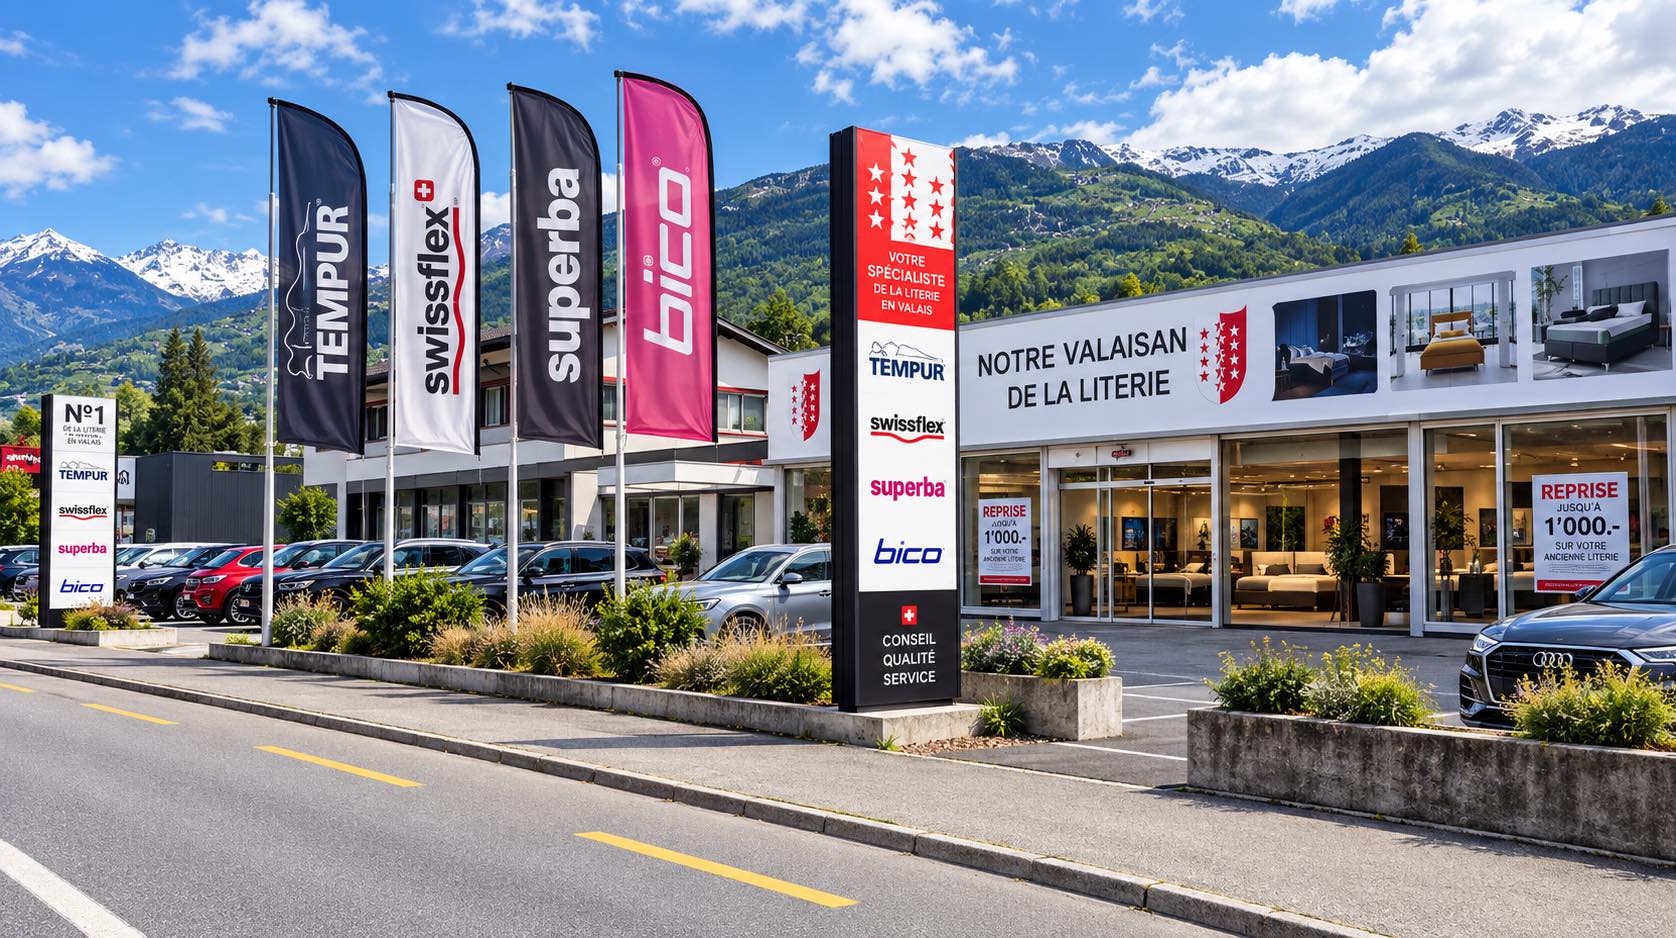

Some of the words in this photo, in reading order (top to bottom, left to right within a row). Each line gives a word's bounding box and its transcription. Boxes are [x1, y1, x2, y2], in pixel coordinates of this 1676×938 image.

[643, 167, 693, 356] bico
[889, 251, 925, 268] VOTRE
[537, 168, 591, 384] superba
[867, 264, 945, 287] SPÉCIALISTE
[317, 205, 349, 381] TEMPUR
[417, 207, 449, 395] swissflex
[874, 283, 887, 294] DE
[889, 285, 902, 296] LA
[905, 288, 940, 302] LITERIE
[881, 299, 895, 311] EN
[898, 301, 933, 316] VALAIS
[978, 344, 1055, 378] NOTRE
[1063, 326, 1187, 366] VALAISAN
[869, 356, 945, 381] TEMPUR
[1008, 383, 1037, 409] DE
[1044, 381, 1072, 406] LA
[1079, 369, 1170, 403] LITERIE
[870, 414, 945, 435] swissflex
[59, 469, 108, 481] TEMPUR
[870, 476, 945, 502] superba
[1541, 482, 1618, 500] REPRISE
[59, 504, 107, 516] swissflex
[983, 505, 1026, 518] REPRISE
[1545, 516, 1620, 536] 1'000.-
[985, 530, 1026, 544] 1'000.-
[1555, 541, 1573, 550] SUR
[1576, 541, 1606, 550] VOTRE
[58, 541, 107, 557] superba
[873, 538, 943, 565] bico
[1544, 552, 1585, 561] ANCIENNE
[1588, 552, 1619, 561] LITERIE
[60, 579, 104, 593] bico
[882, 633, 936, 648] CONSEIL
[883, 649, 936, 668] QUALITÉ
[883, 670, 936, 687] SERVICE
